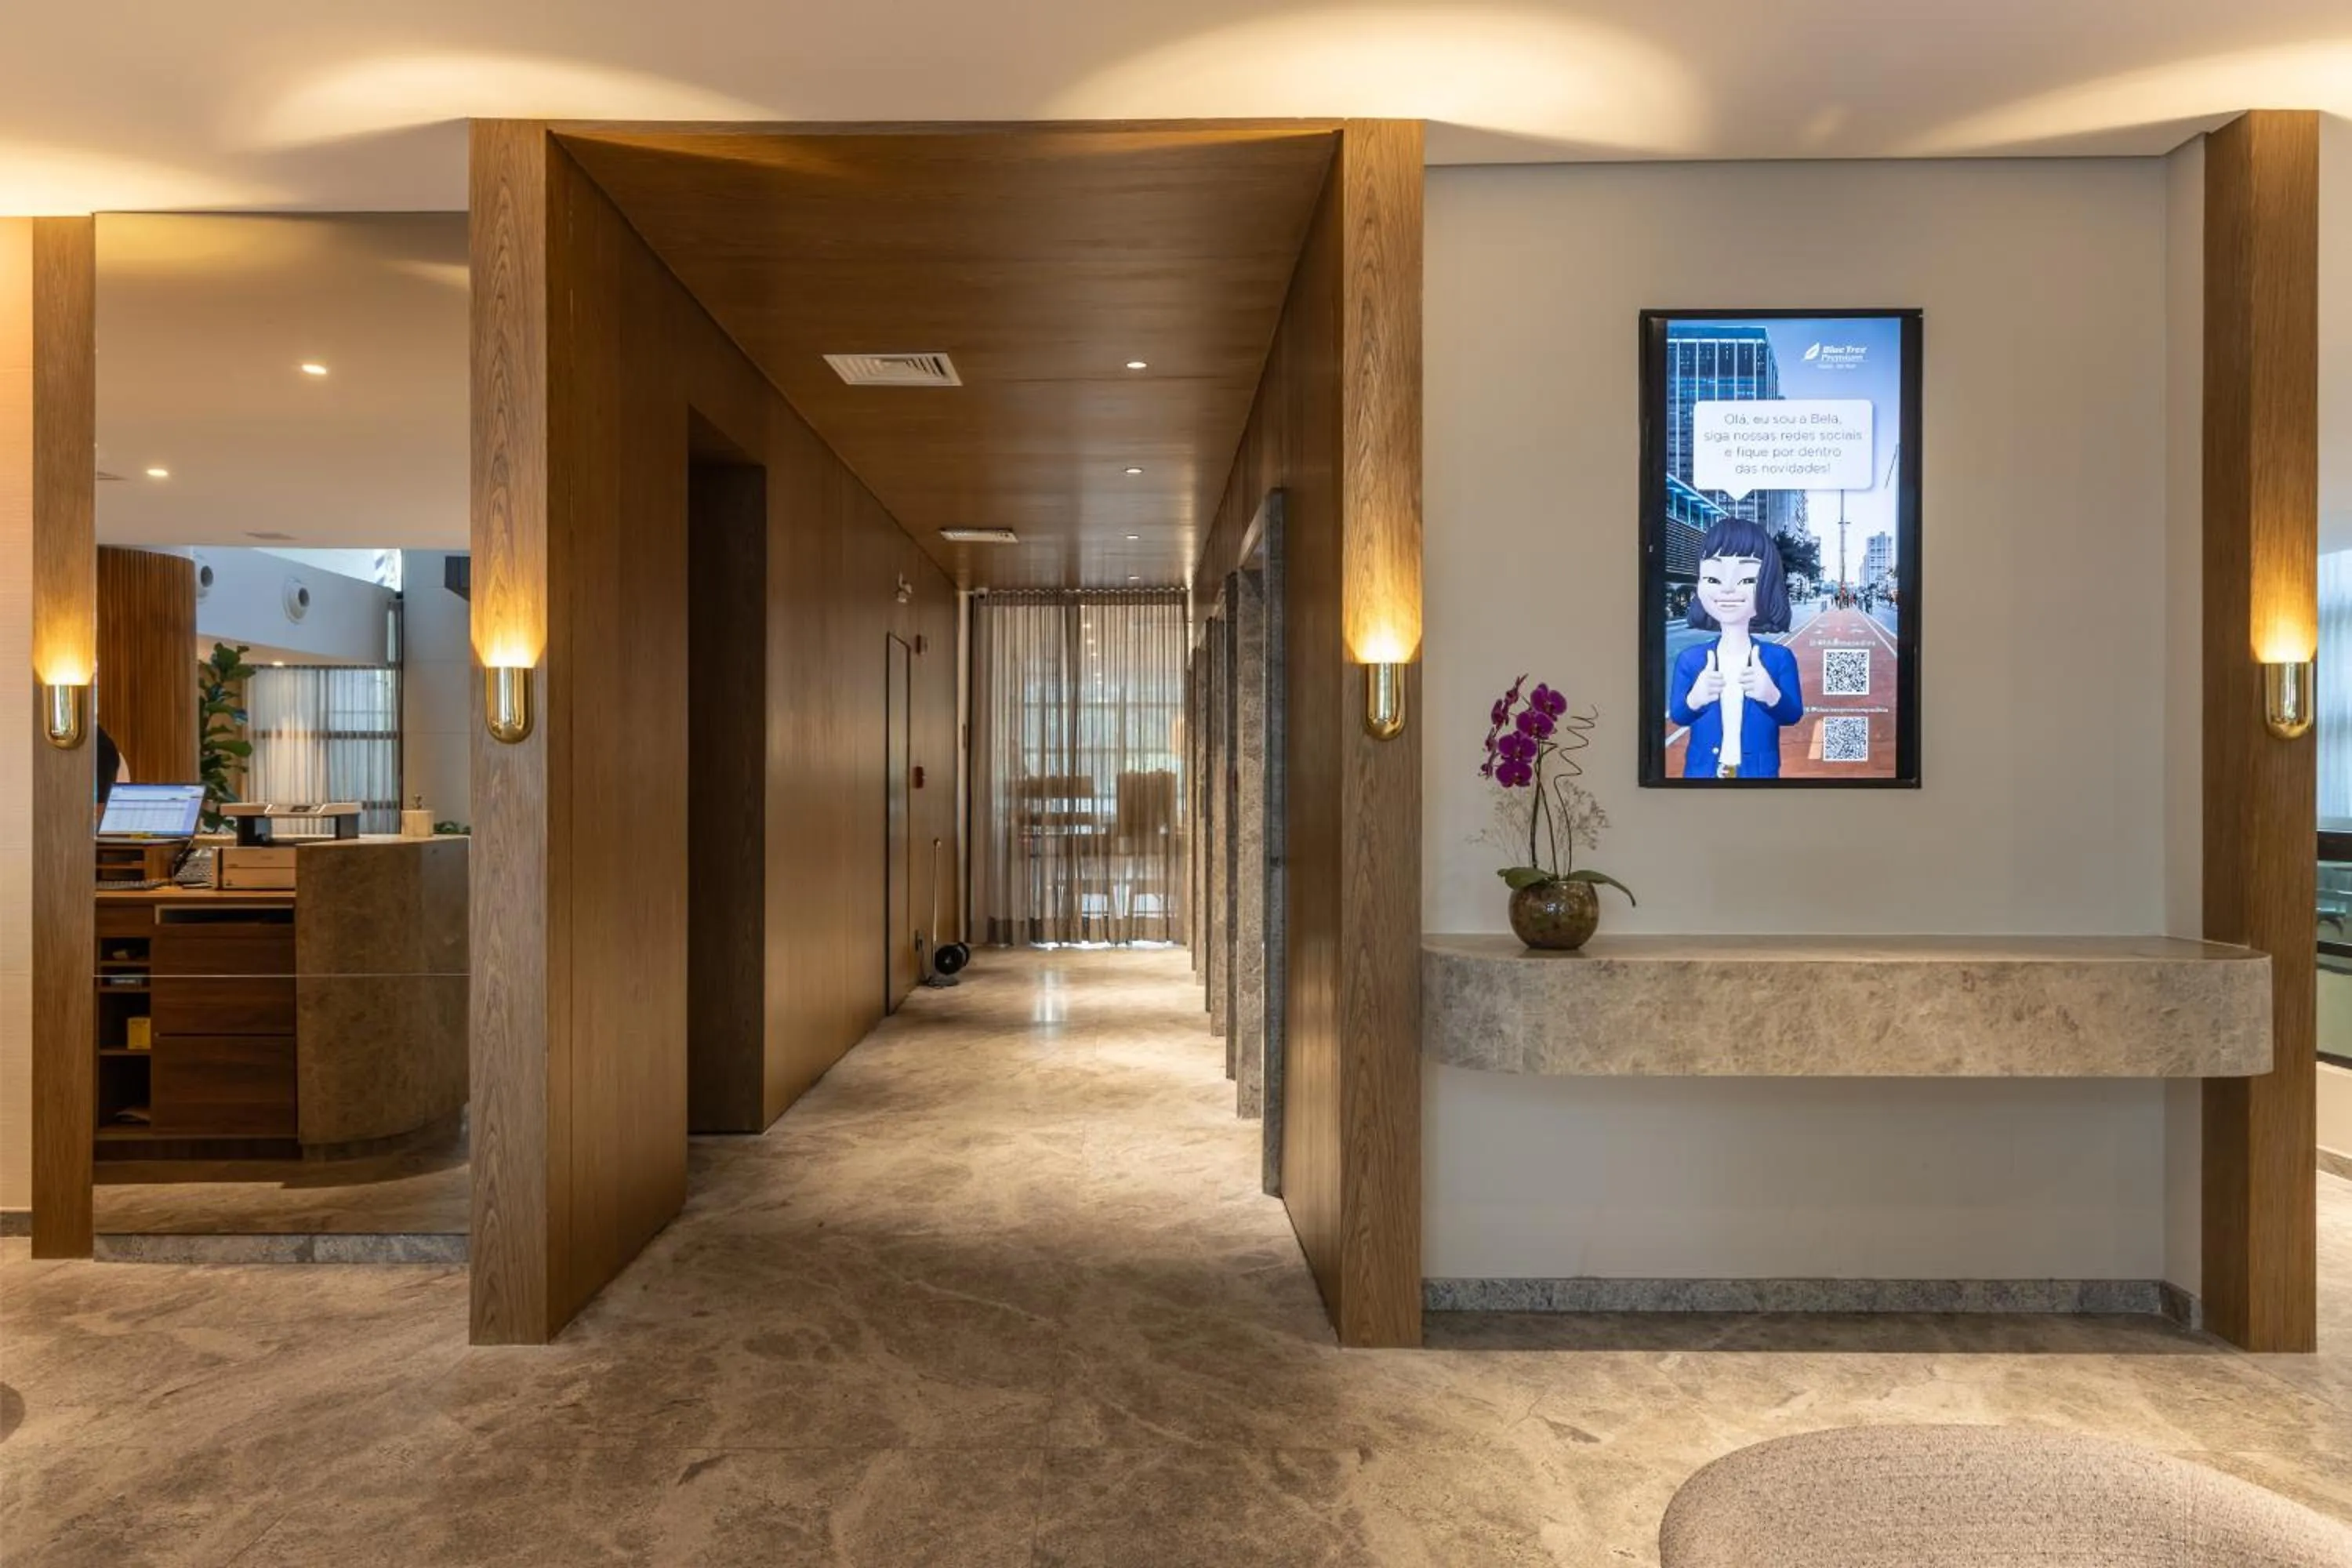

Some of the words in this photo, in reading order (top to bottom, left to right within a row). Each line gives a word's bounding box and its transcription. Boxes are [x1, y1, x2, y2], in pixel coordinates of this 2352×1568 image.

[1823, 345, 1845, 354] Blue
[1846, 345, 1867, 354] Tree
[1724, 412, 1749, 426] Olá,
[1799, 416, 1806, 424] a
[1704, 431, 1730, 443] siga
[1733, 432, 1776, 441] nossas
[1780, 430, 1815, 441] redes
[1820, 430, 1863, 441] sociais
[1725, 448, 1732, 457] e
[1737, 446, 1769, 459] fique
[1773, 448, 1794, 459] por
[1798, 446, 1842, 457] dentro
[1735, 463, 1757, 474] das
[1762, 463, 1831, 474] novidades!
